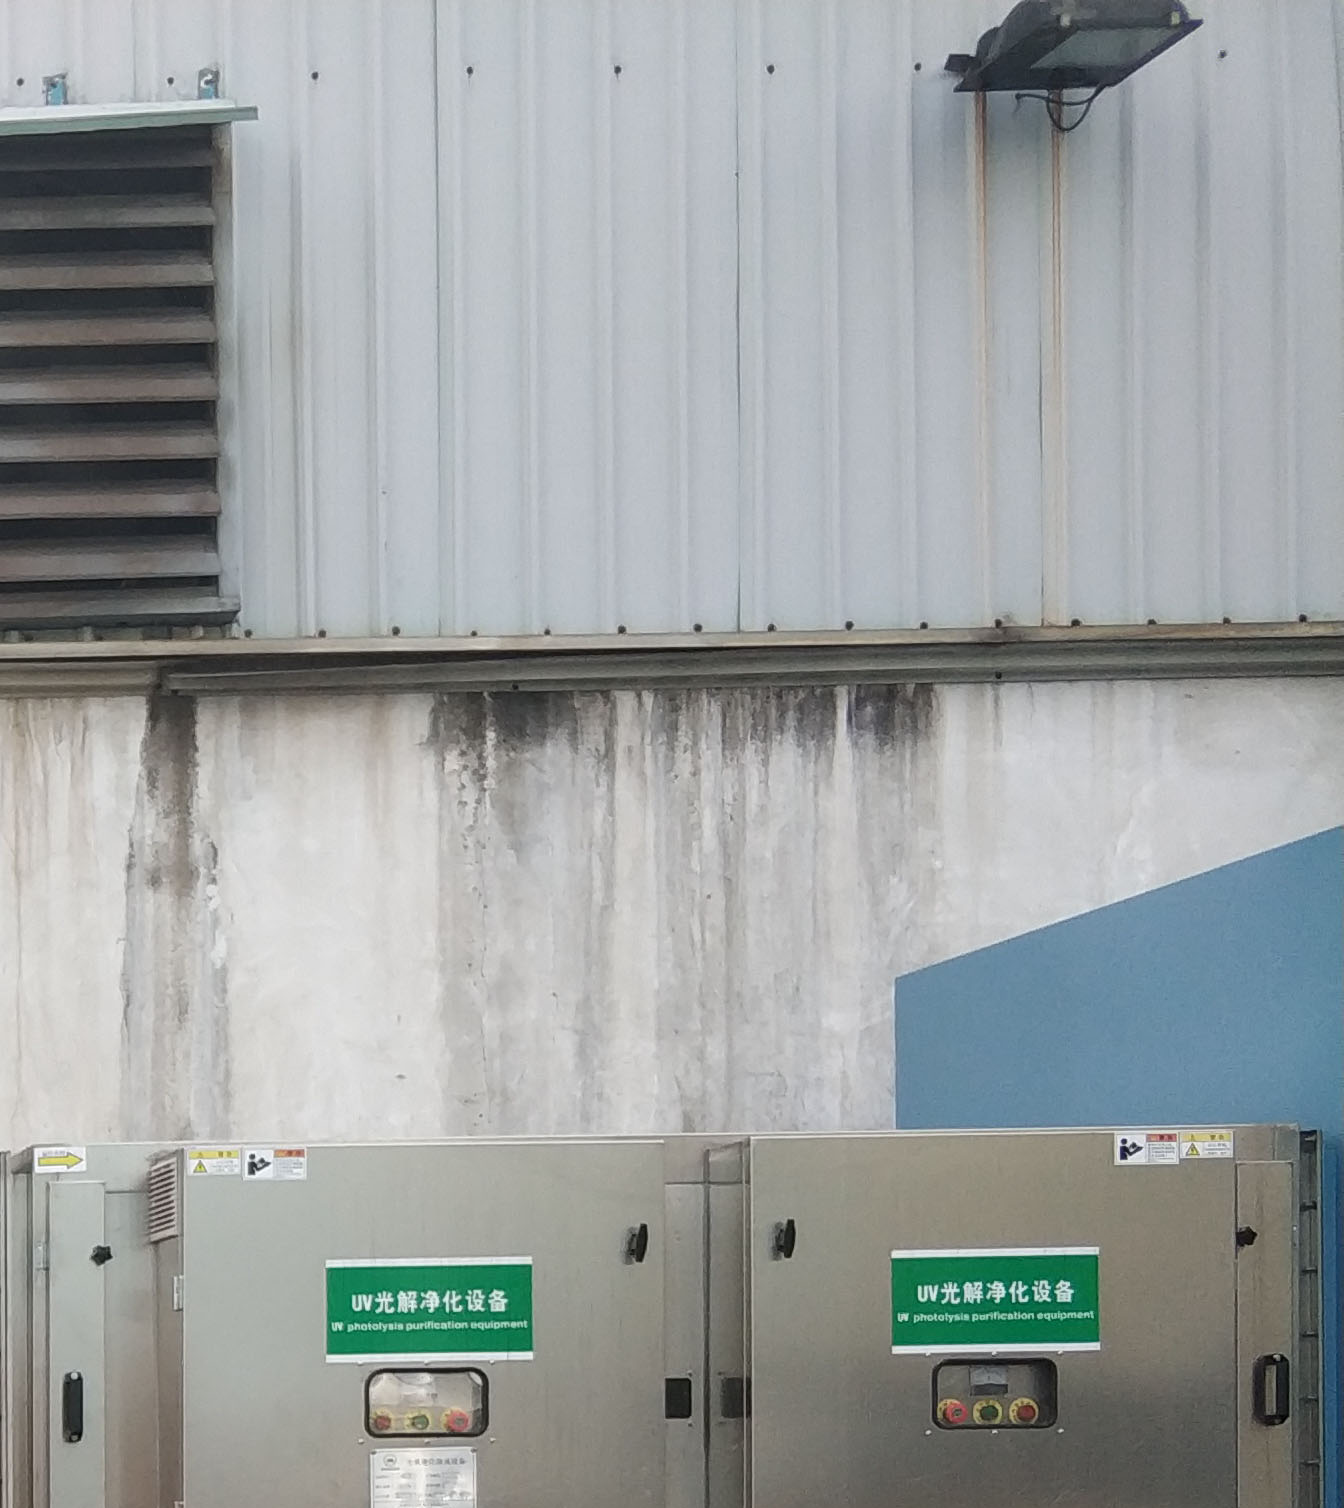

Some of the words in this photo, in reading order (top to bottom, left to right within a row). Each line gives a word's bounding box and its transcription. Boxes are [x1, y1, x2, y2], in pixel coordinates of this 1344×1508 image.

[917, 1280, 1074, 1304] UV光解净化设备
[352, 1290, 508, 1313] UV光解净化设备
[897, 1313, 909, 1321] UV
[1037, 1311, 1094, 1320] equipment
[332, 1322, 343, 1332] UV
[471, 1320, 528, 1330] equipment
